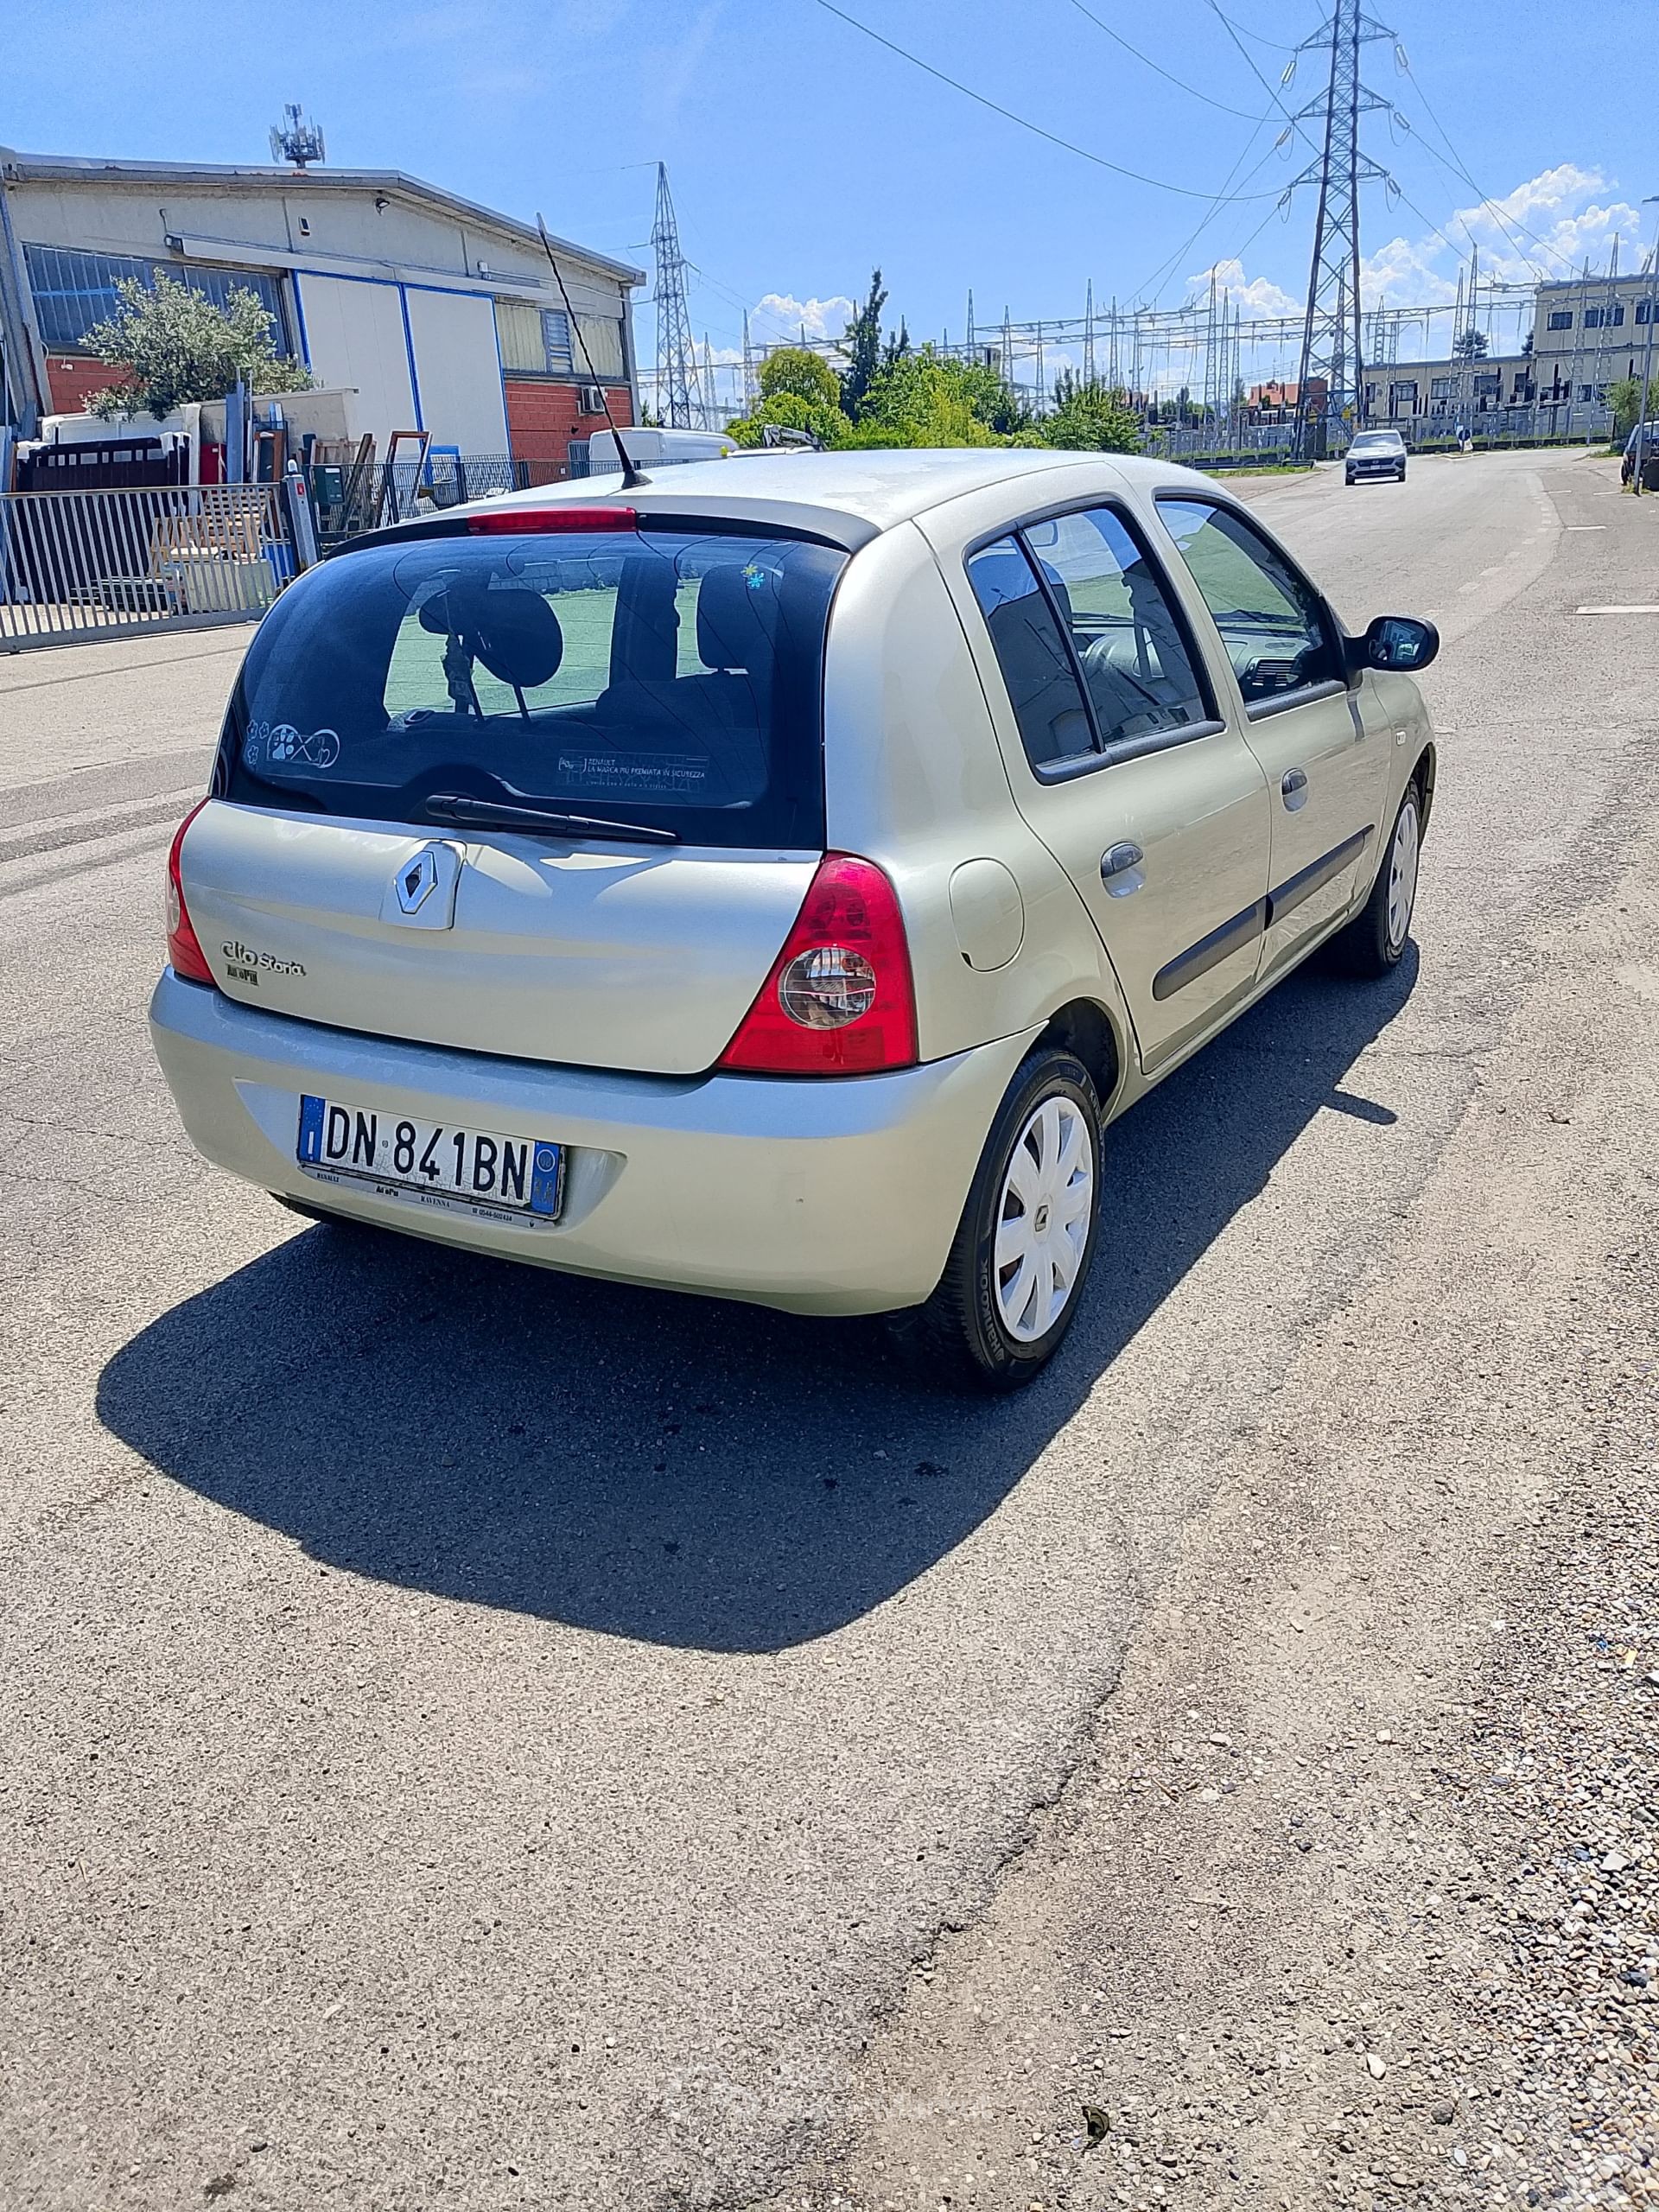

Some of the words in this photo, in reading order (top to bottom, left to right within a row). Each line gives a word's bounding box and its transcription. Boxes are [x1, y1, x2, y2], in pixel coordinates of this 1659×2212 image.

[221, 940, 258, 965] Clio
[258, 952, 307, 976] Storia
[326, 1105, 377, 1167] DN
[393, 1121, 528, 1201] 841BN
[420, 1195, 450, 1208] RAVENNA
